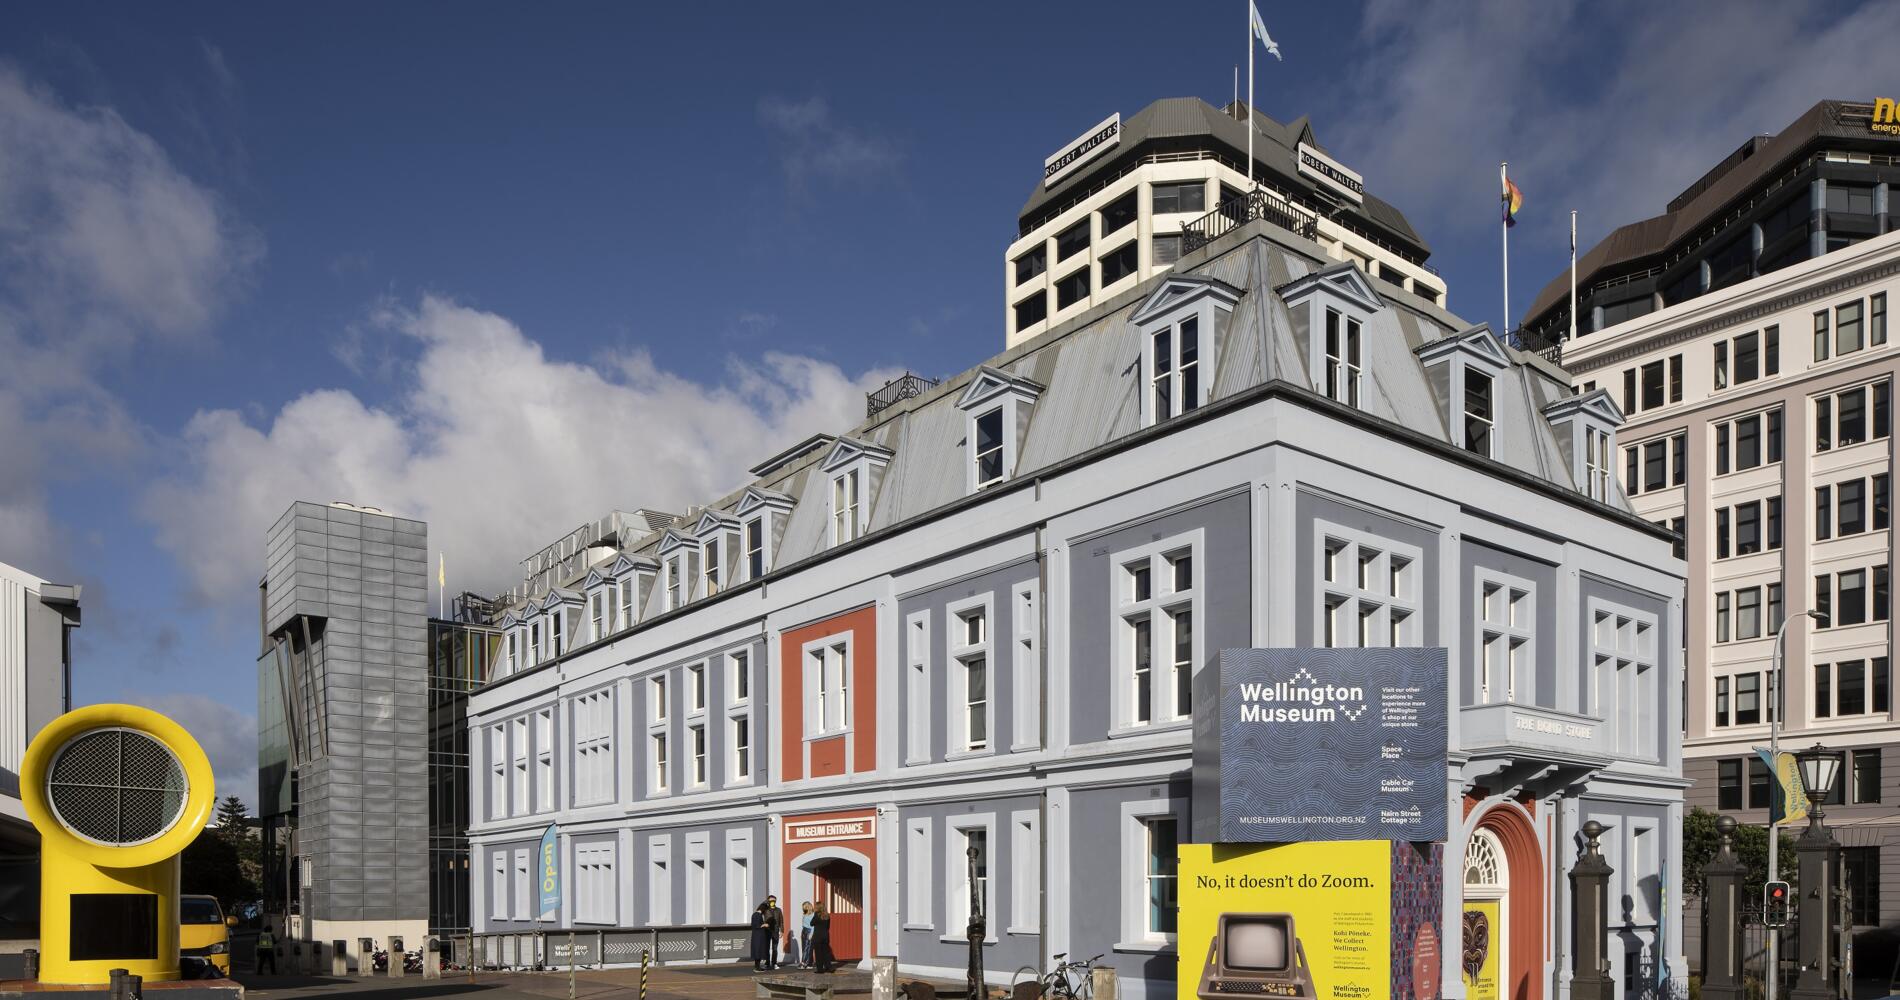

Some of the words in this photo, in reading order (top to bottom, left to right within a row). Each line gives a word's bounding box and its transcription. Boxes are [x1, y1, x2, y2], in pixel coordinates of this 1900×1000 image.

[1873, 97, 1900, 123] n
[1045, 151, 1077, 177] ROBERT
[1080, 123, 1117, 154] WALTERS
[1301, 152, 1329, 175] ROBERT
[1332, 169, 1363, 194] WALTERS
[1240, 683, 1363, 706] Wellington
[1240, 704, 1335, 722] Museum
[1515, 716, 1535, 731] THE
[1537, 719, 1562, 735] BOND
[1565, 724, 1592, 739] STORE
[1381, 746, 1402, 754] Space
[1788, 762, 1798, 813] Wellington
[796, 825, 826, 838] MUSEUM
[826, 822, 864, 835] ENTRANCE
[1240, 816, 1366, 824] MUSEUMSWELLINGTON.ORG.NZ
[543, 842, 557, 893] Open
[1196, 875, 1221, 891] No,
[1225, 874, 1236, 888] it
[1298, 874, 1319, 888] do
[1321, 874, 1375, 888] Zoom.
[1333, 985, 1370, 993] Wellington
